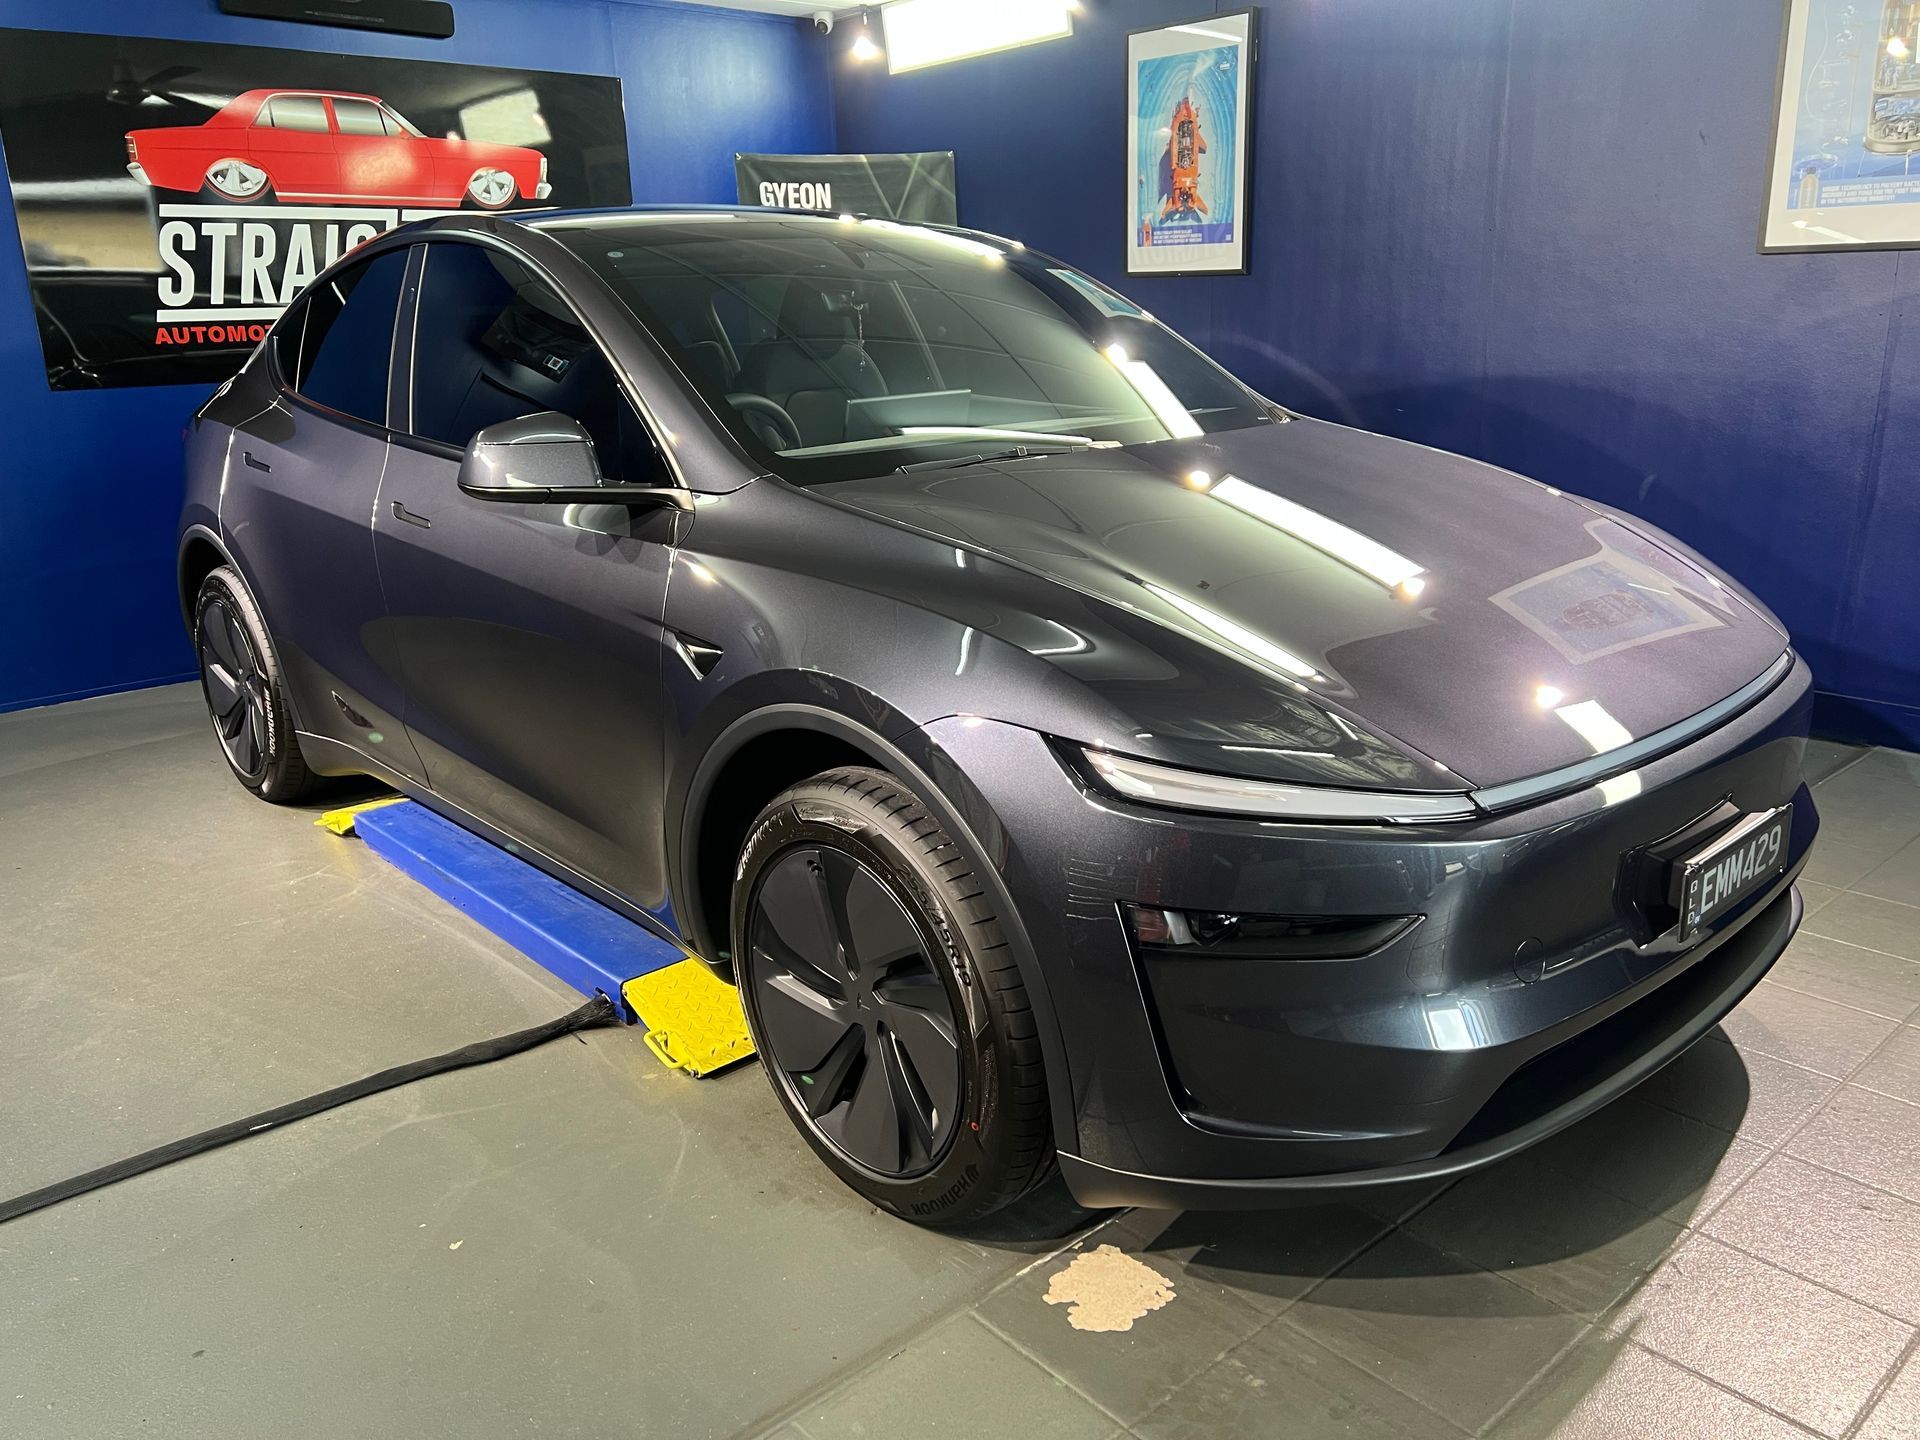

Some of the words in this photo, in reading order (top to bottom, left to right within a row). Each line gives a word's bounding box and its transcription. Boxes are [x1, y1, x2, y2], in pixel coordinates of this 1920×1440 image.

[760, 181, 832, 208] GYEON
[158, 221, 377, 306] STRAI
[155, 324, 273, 344] AUTOMO
[1701, 824, 1782, 914] EMM429
